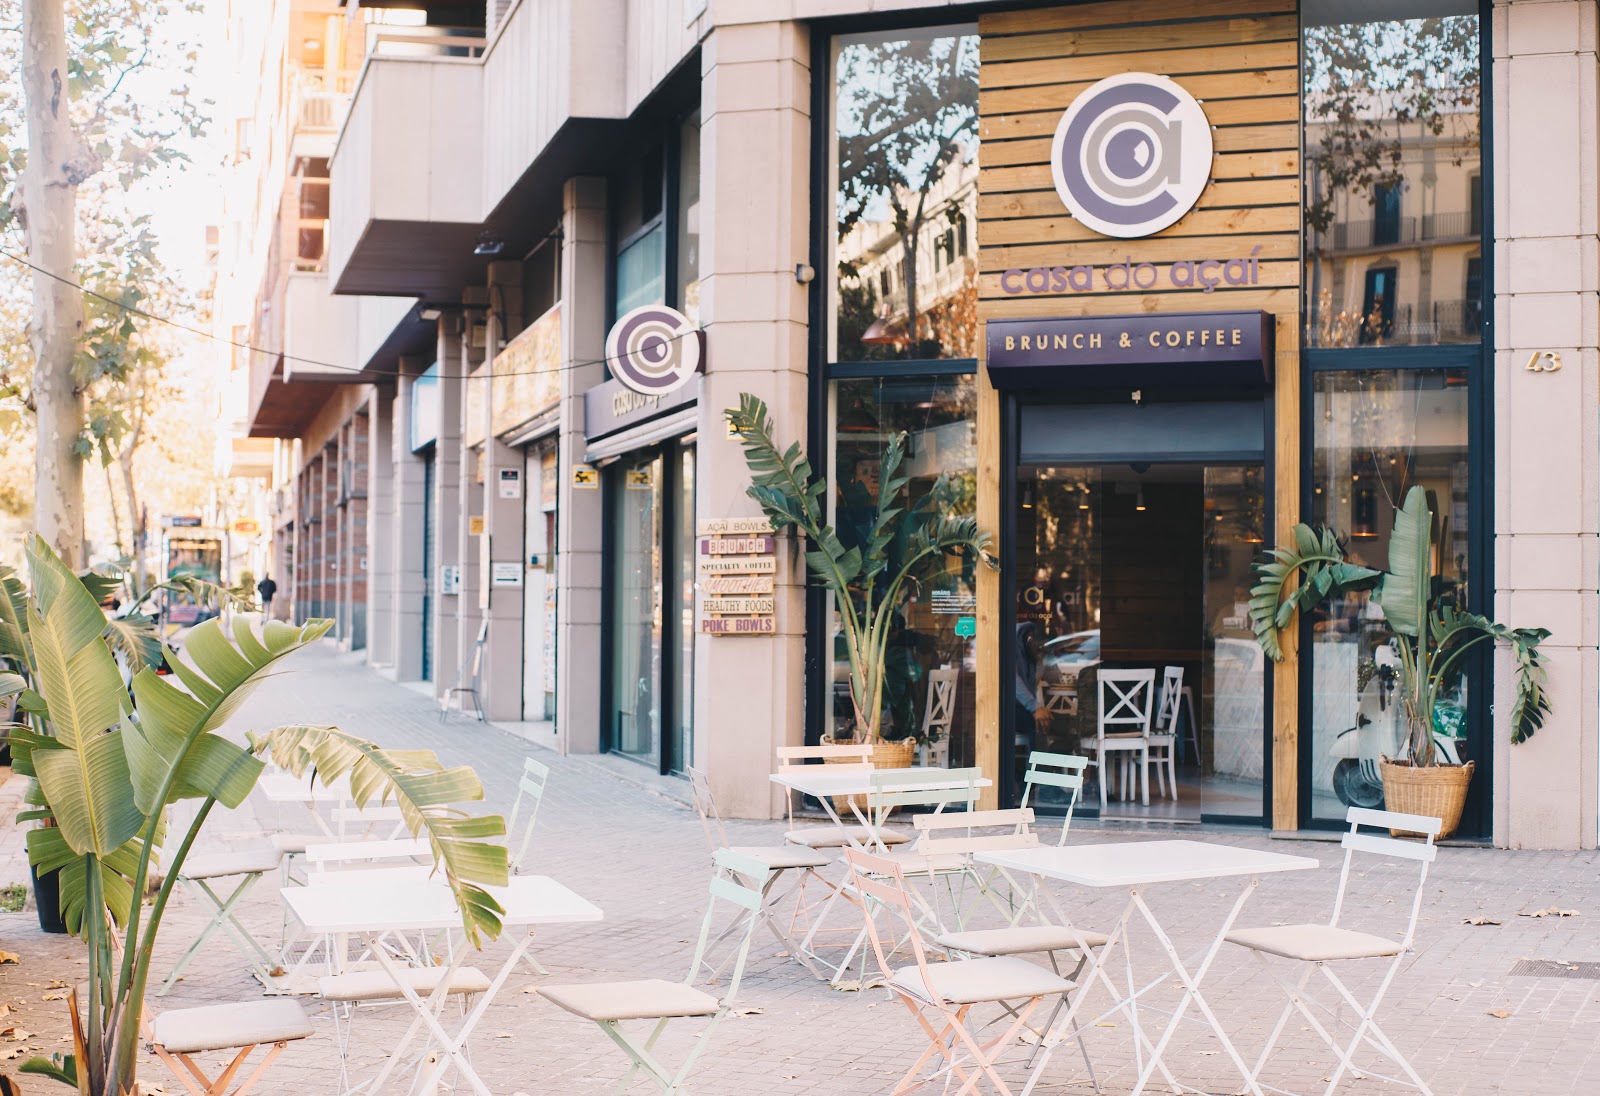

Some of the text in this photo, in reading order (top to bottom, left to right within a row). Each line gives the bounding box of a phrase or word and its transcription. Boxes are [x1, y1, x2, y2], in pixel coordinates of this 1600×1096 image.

[1001, 245, 1262, 294] casa do açaí
[1005, 329, 1242, 350] BRUNCH & COFFEE
[1526, 351, 1562, 372] 43
[734, 522, 767, 531] BOWLS
[711, 541, 763, 552] BRUNCH
[702, 563, 740, 571] SPECIALTY
[702, 579, 771, 593] SMOOTHIES
[703, 600, 772, 611] HEALTHY FOODS
[703, 619, 772, 632] POKE BOWLS
